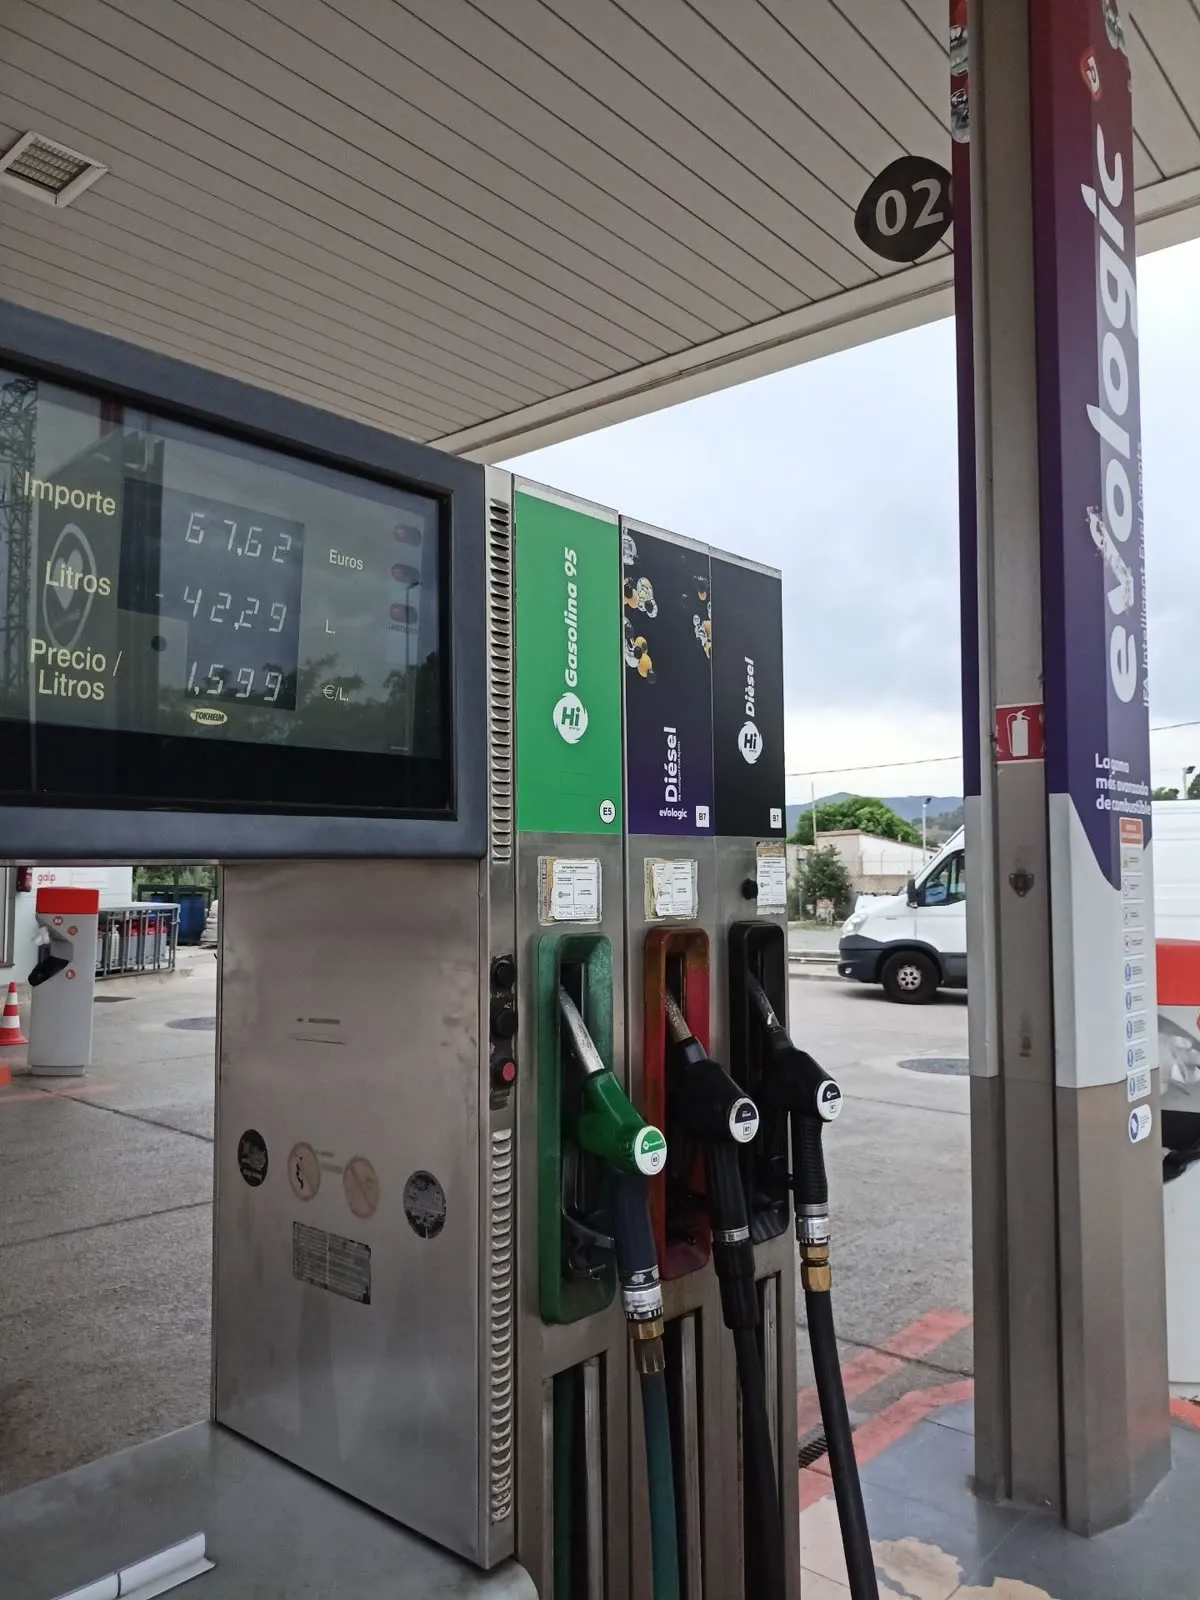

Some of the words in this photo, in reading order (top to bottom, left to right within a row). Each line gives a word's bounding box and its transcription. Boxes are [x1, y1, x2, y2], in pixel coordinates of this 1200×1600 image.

[876, 178, 944, 236] 02
[1081, 123, 1138, 703] evologic
[24, 471, 116, 516] Importe
[185, 512, 292, 564] 67,62
[329, 549, 363, 570] Euros
[564, 546, 577, 577] 95
[45, 561, 111, 596] Litros
[183, 586, 287, 632] 42,29
[325, 619, 336, 634] L.
[564, 582, 578, 688] Gasolina
[30, 638, 107, 672] Precio
[38, 669, 105, 700] Litros
[187, 661, 283, 702] 1,599
[561, 706, 581, 727] Hi
[743, 733, 757, 749] Hi
[664, 726, 677, 802] Diésel
[1095, 753, 1110, 769] La
[603, 807, 612, 816] E5
[659, 807, 687, 820] evologic
[699, 812, 707, 821] B7
[1096, 794, 1111, 810] de
